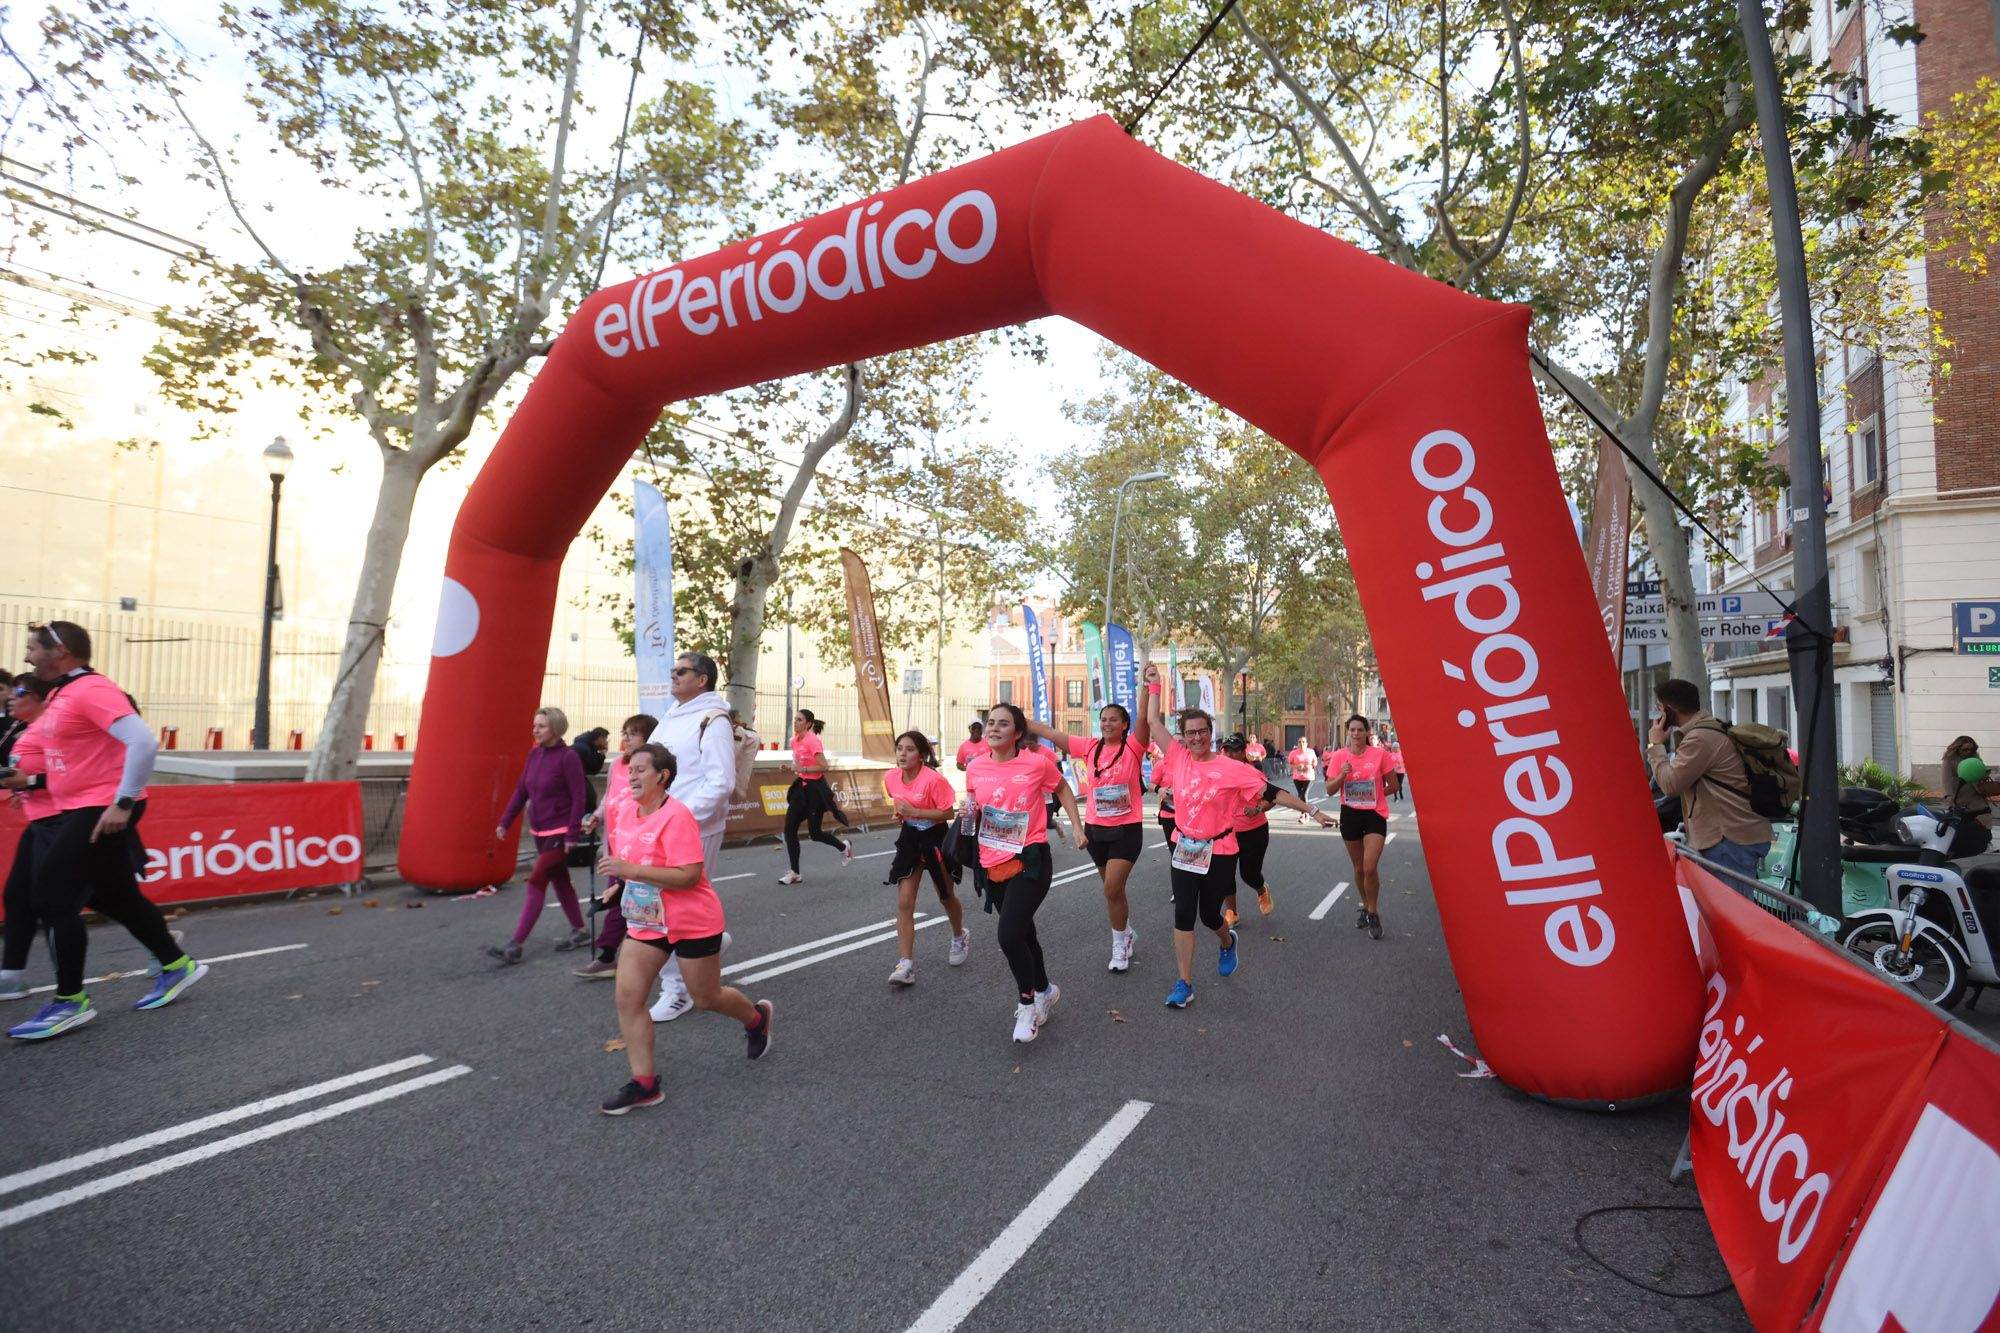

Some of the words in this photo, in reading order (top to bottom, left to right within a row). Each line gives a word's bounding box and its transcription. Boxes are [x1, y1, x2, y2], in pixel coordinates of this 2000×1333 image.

[594, 189, 998, 358] elPeriódico
[1625, 627, 1657, 640] Mies
[1721, 622, 1761, 636] Rohe
[1970, 607, 1996, 633] P
[1410, 429, 1616, 968] elPeriódico
